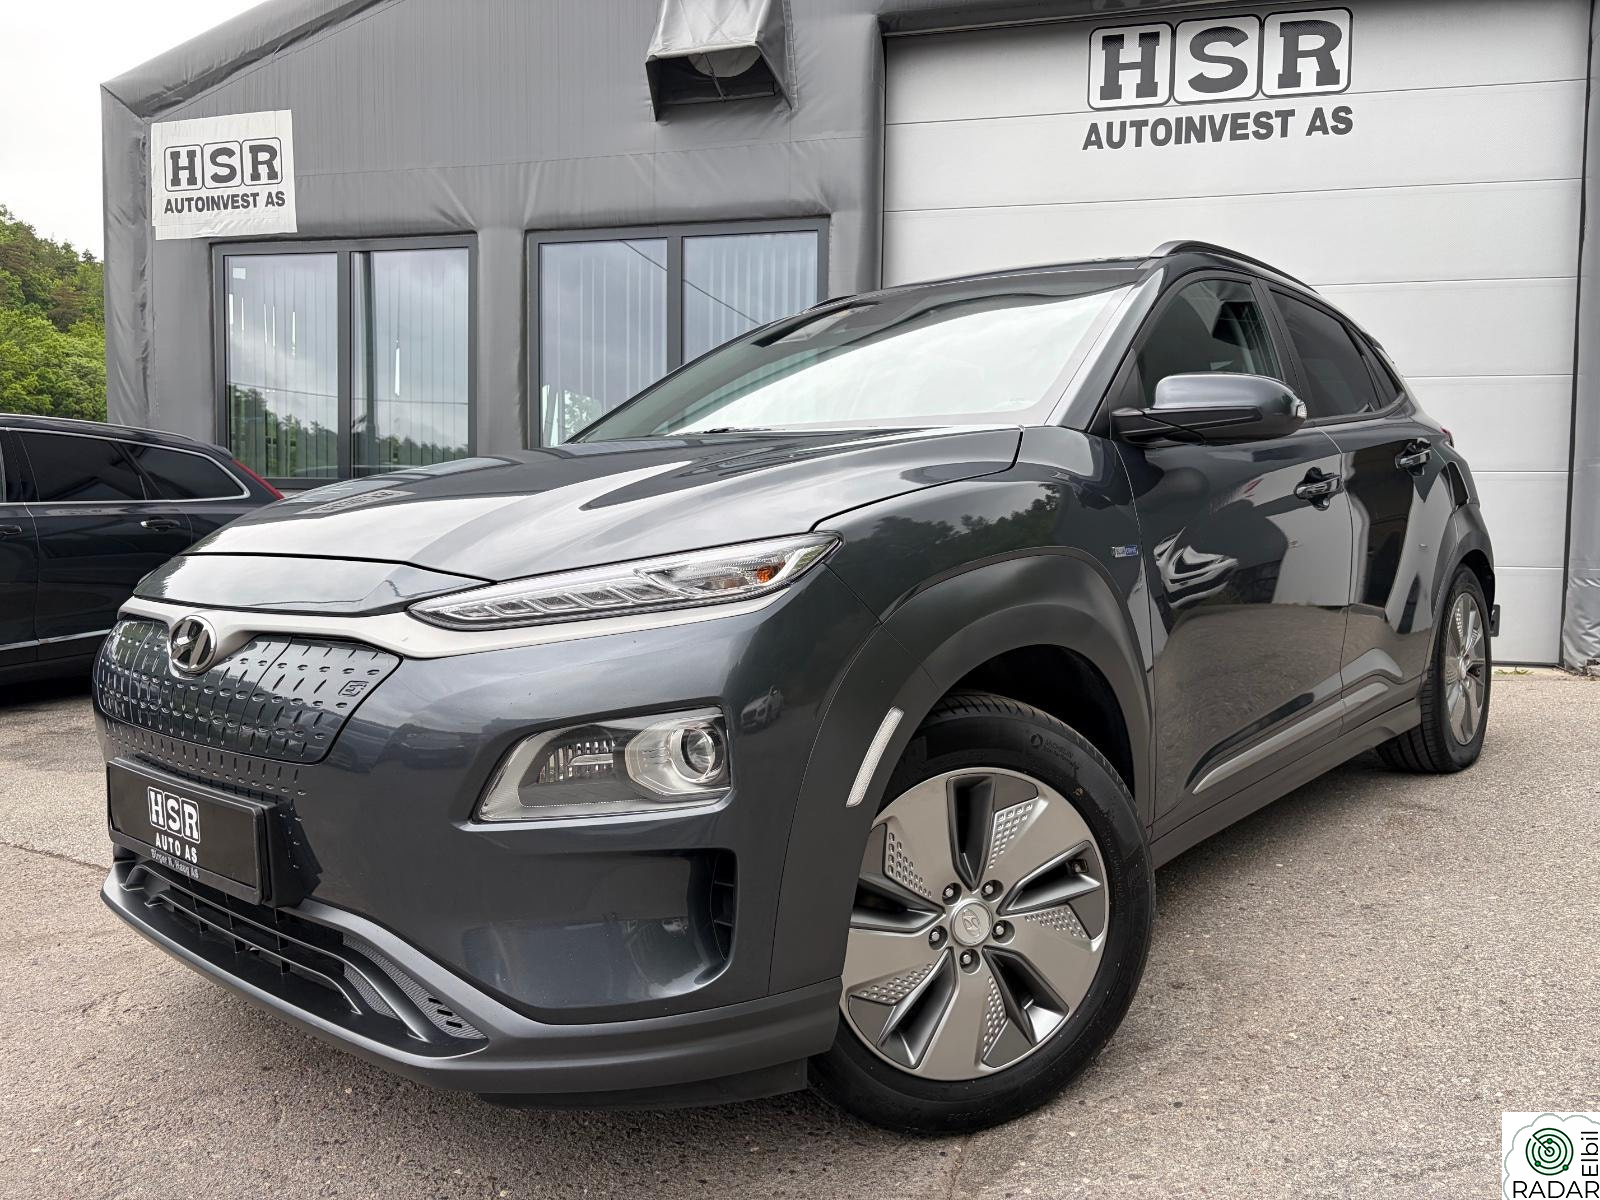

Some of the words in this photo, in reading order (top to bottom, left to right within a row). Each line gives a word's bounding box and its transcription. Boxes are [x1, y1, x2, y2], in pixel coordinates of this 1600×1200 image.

[1099, 19, 1343, 101] HSR
[1082, 109, 1296, 151] AUTOINVEST
[1305, 105, 1354, 137] AS
[169, 143, 279, 187] HSR
[163, 192, 260, 214] AUTOINVEST
[264, 190, 286, 208] AS
[149, 790, 200, 841] HSR
[155, 832, 181, 857] AUTO
[184, 844, 198, 864] AS
